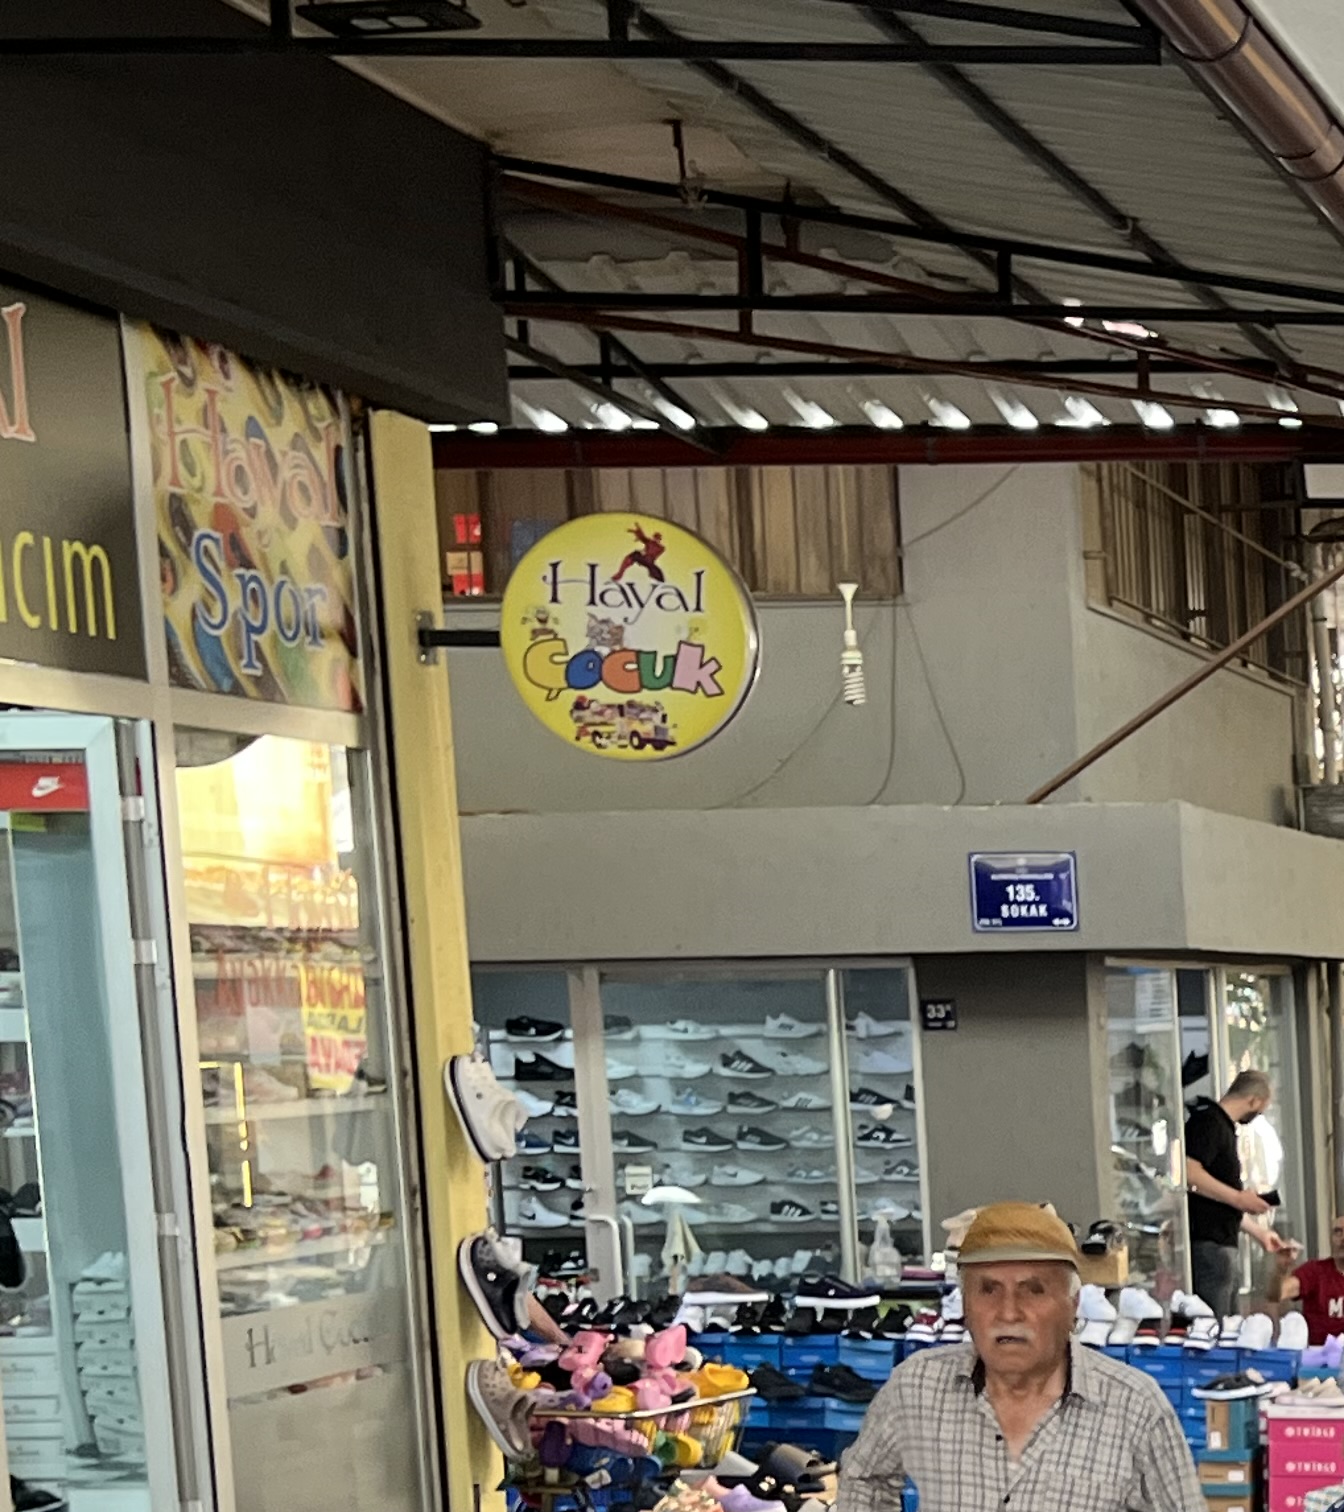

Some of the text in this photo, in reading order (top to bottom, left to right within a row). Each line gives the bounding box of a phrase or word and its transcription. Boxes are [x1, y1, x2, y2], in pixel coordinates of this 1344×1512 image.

[190, 527, 329, 676] Spor
[542, 559, 706, 626] Hayal
[1000, 903, 1048, 919] SOKAK
